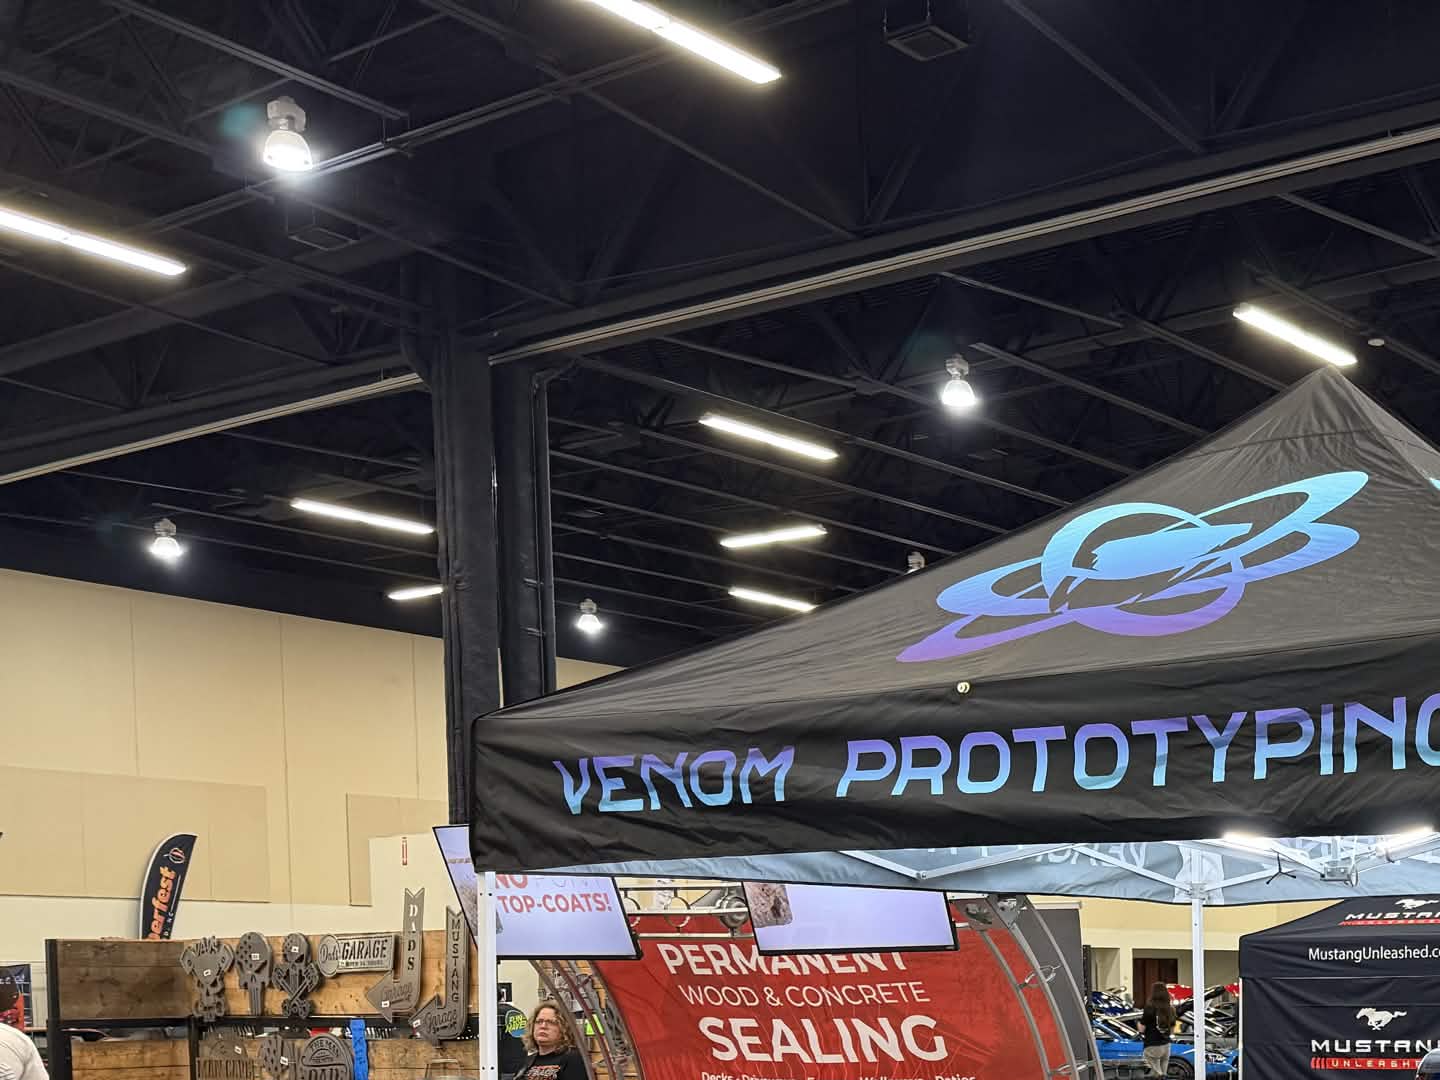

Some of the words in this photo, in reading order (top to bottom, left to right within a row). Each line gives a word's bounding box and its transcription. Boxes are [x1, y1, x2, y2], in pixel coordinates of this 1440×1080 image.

[553, 746, 796, 815] VENOM
[497, 893, 612, 914] TOP-COATS!
[341, 939, 387, 961] GARAGE
[678, 984, 759, 1007] WOOD
[765, 986, 784, 1006] &
[785, 981, 931, 1008] CONCRETE
[698, 1014, 949, 1065] SEALING
